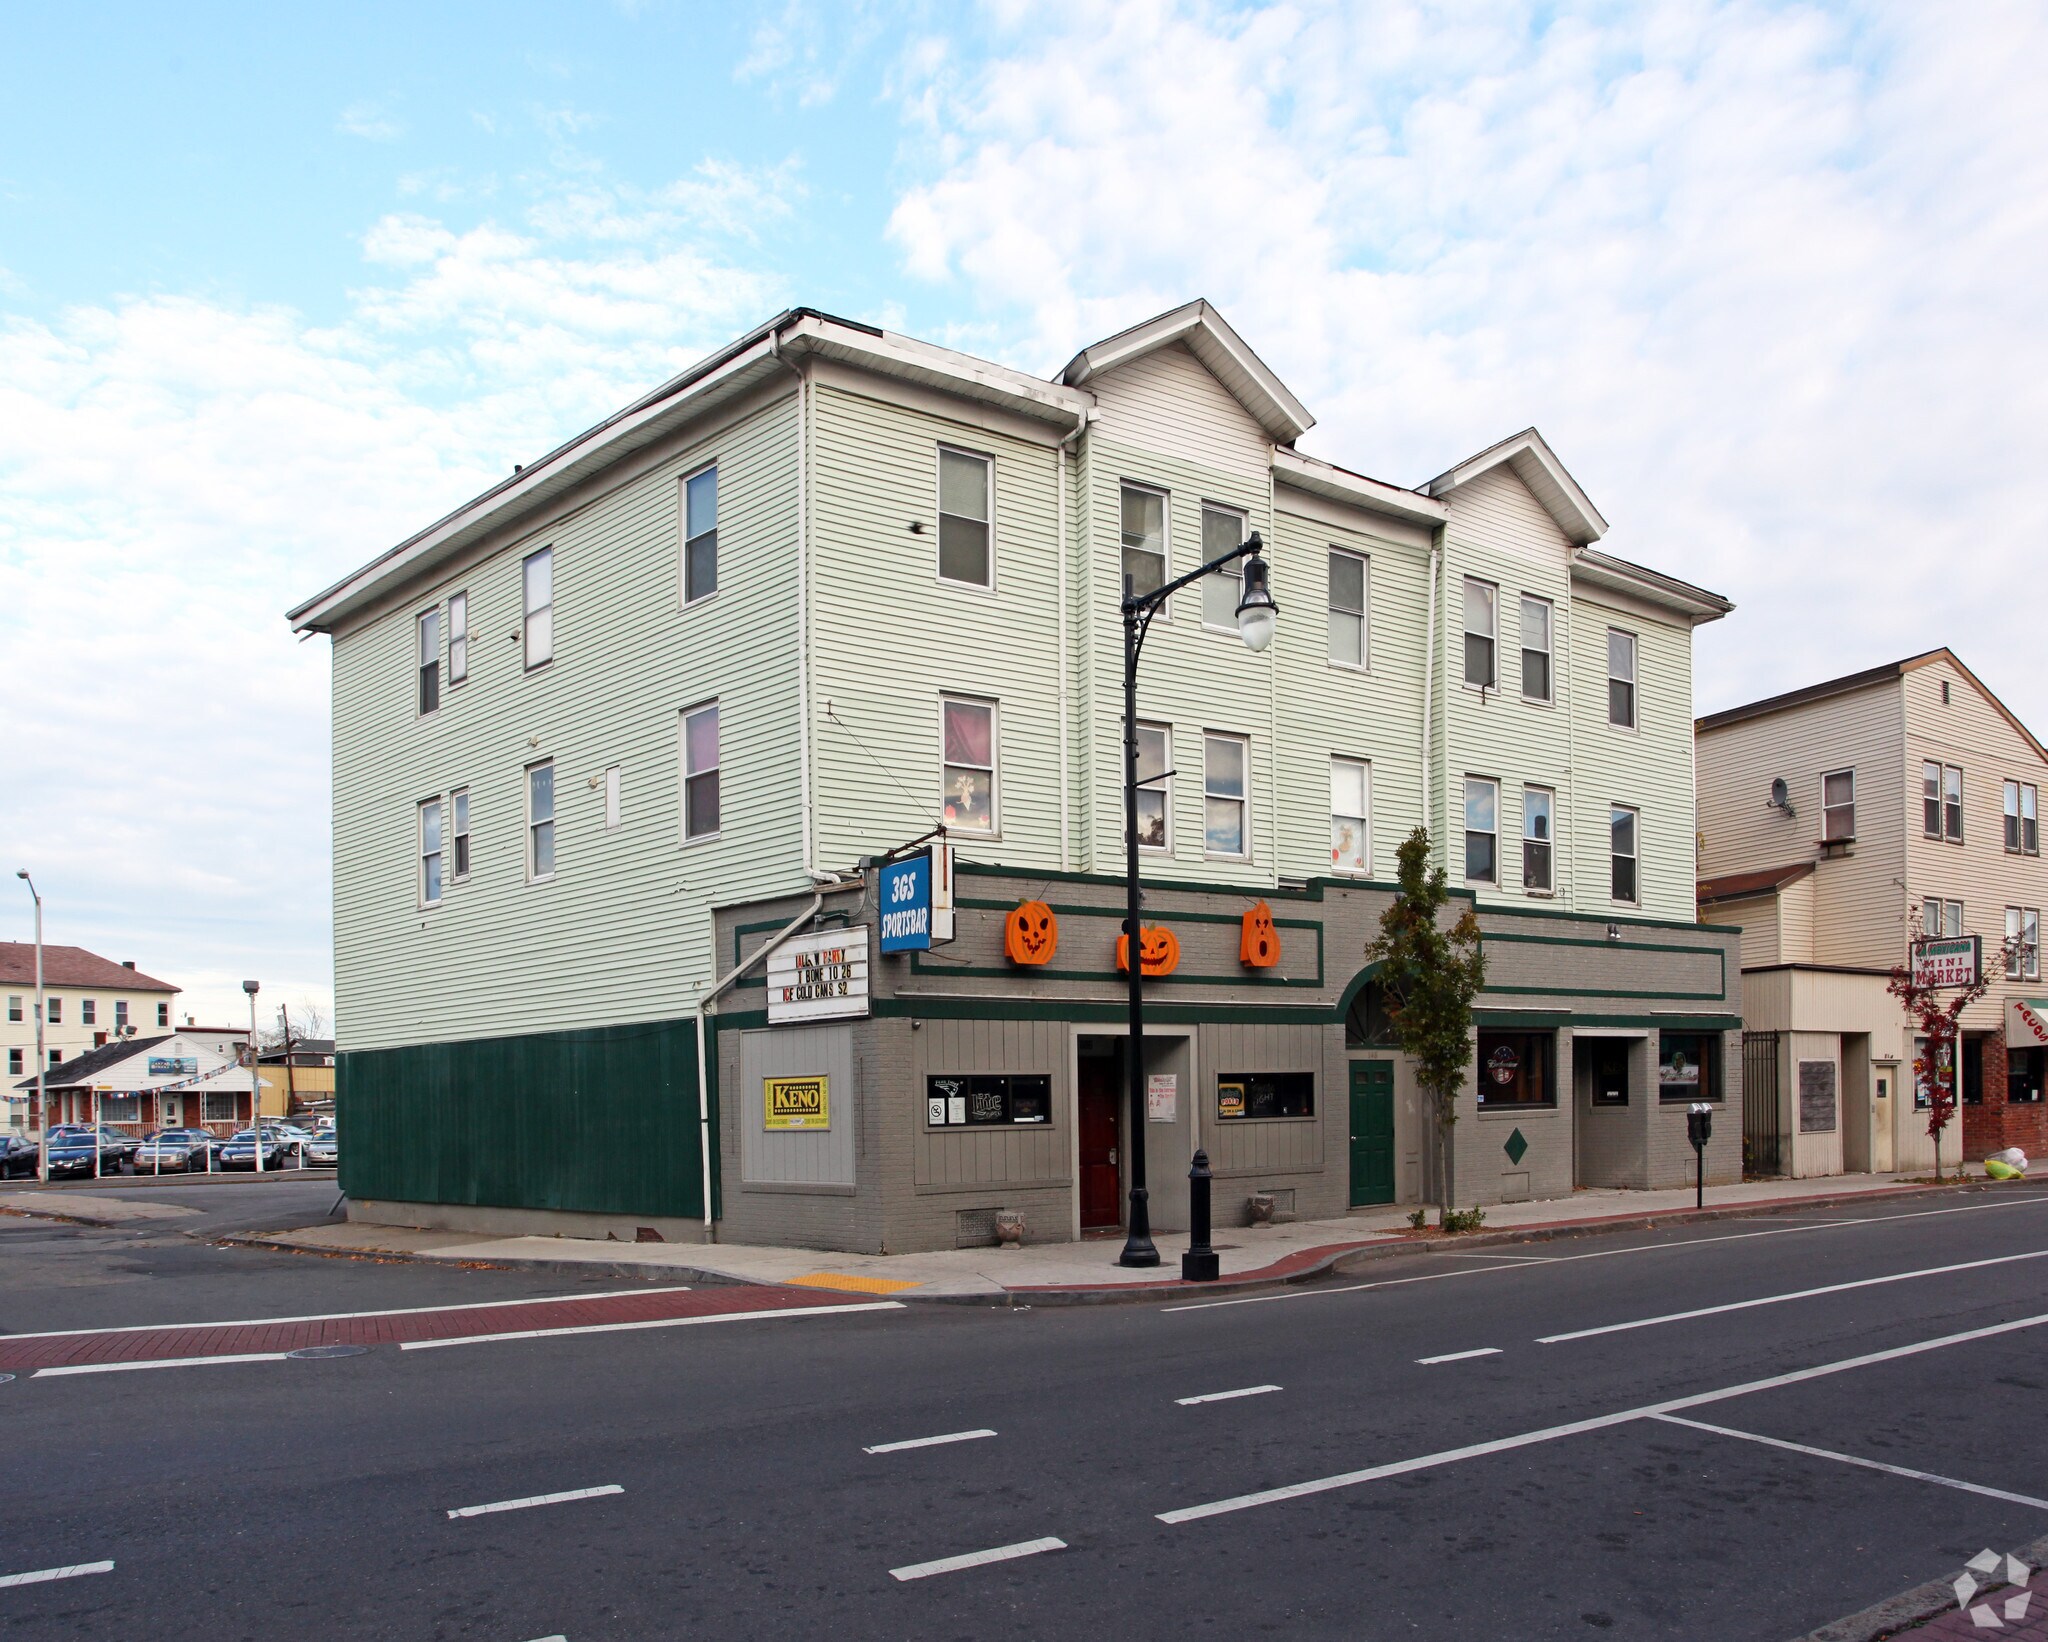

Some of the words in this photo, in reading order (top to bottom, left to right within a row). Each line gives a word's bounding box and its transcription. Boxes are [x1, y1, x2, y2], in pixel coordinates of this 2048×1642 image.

[891, 871, 916, 903] 3GS
[882, 907, 927, 939] SPORTSBAR
[823, 949, 846, 965] PARTY
[1928, 940, 1971, 956] MEXICANA
[1923, 957, 1963, 968] MINI
[798, 970, 802, 984] T
[805, 968, 823, 983] BONE
[829, 966, 838, 980] 10
[841, 964, 851, 978] 26
[1915, 967, 1972, 985] MARKET
[783, 987, 794, 1002] ICE
[796, 986, 812, 1000] COLD
[815, 983, 833, 998] CANS
[774, 1085, 819, 1108] KENO
